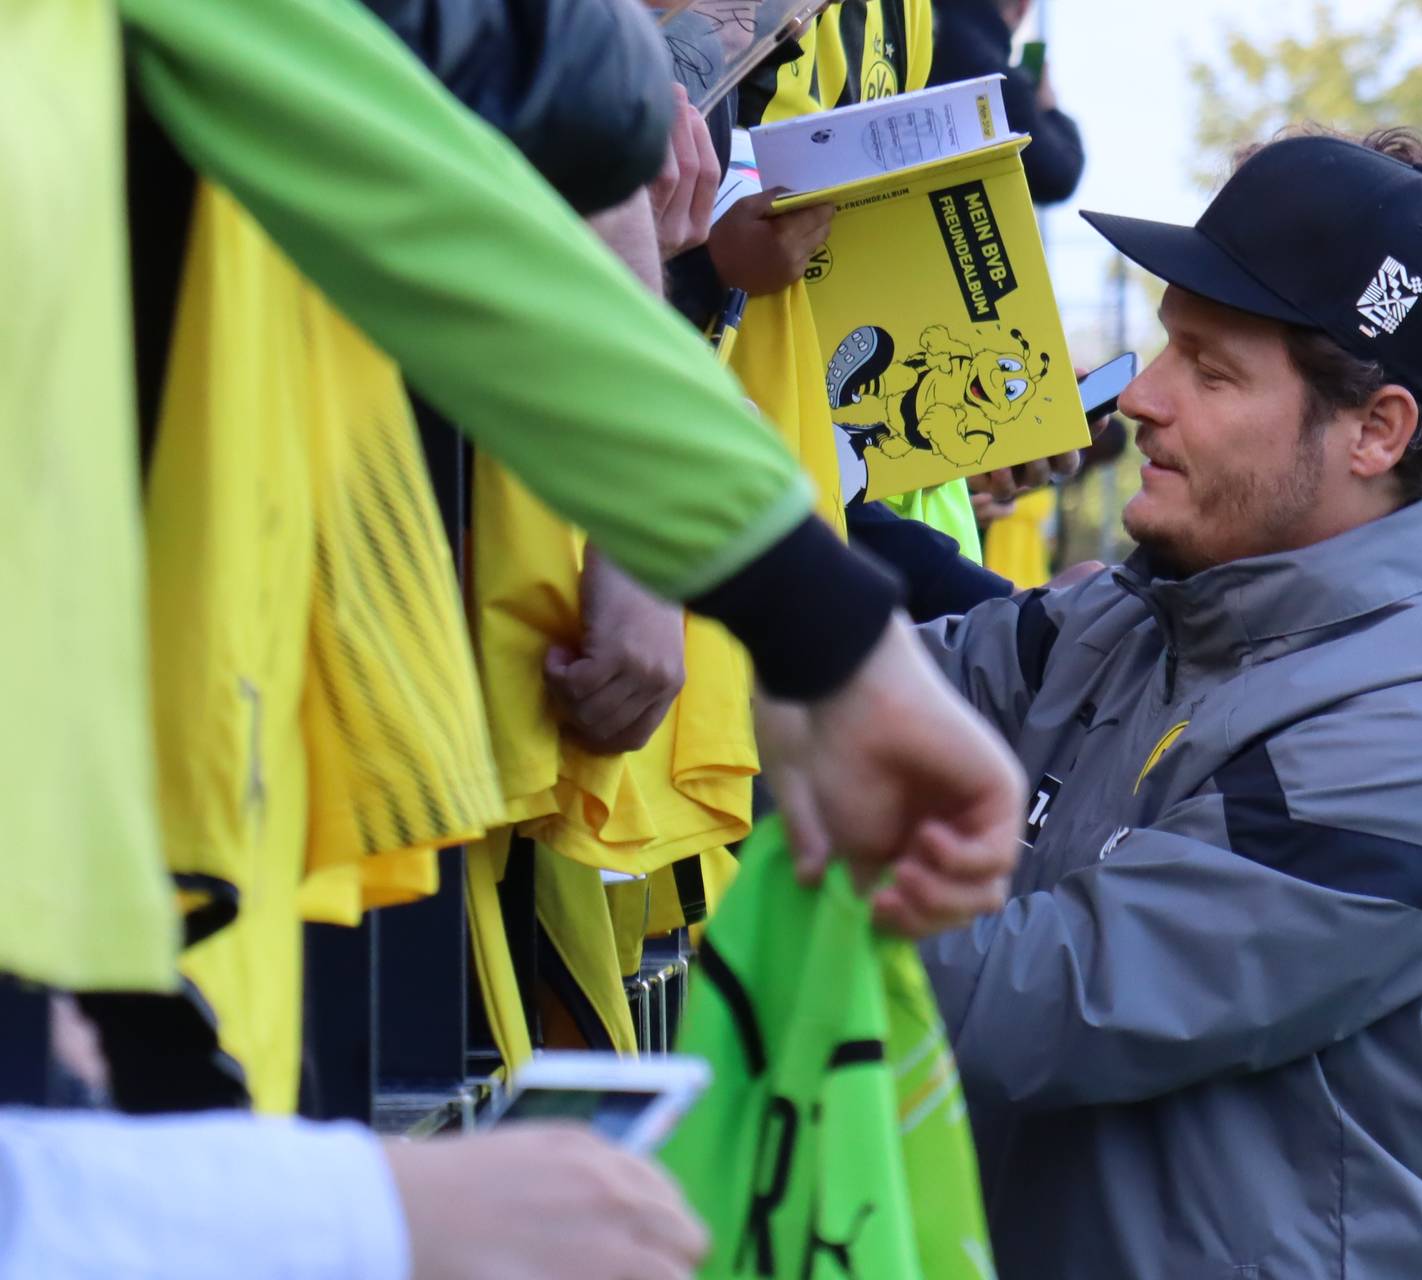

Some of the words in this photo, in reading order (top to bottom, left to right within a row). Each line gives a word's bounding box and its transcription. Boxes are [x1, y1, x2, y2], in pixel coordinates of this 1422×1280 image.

[804, 249, 830, 280] VB
[939, 195, 990, 315] FREUNDEALBUM
[964, 192, 994, 241] MEIN
[981, 242, 1007, 289] BVB-
